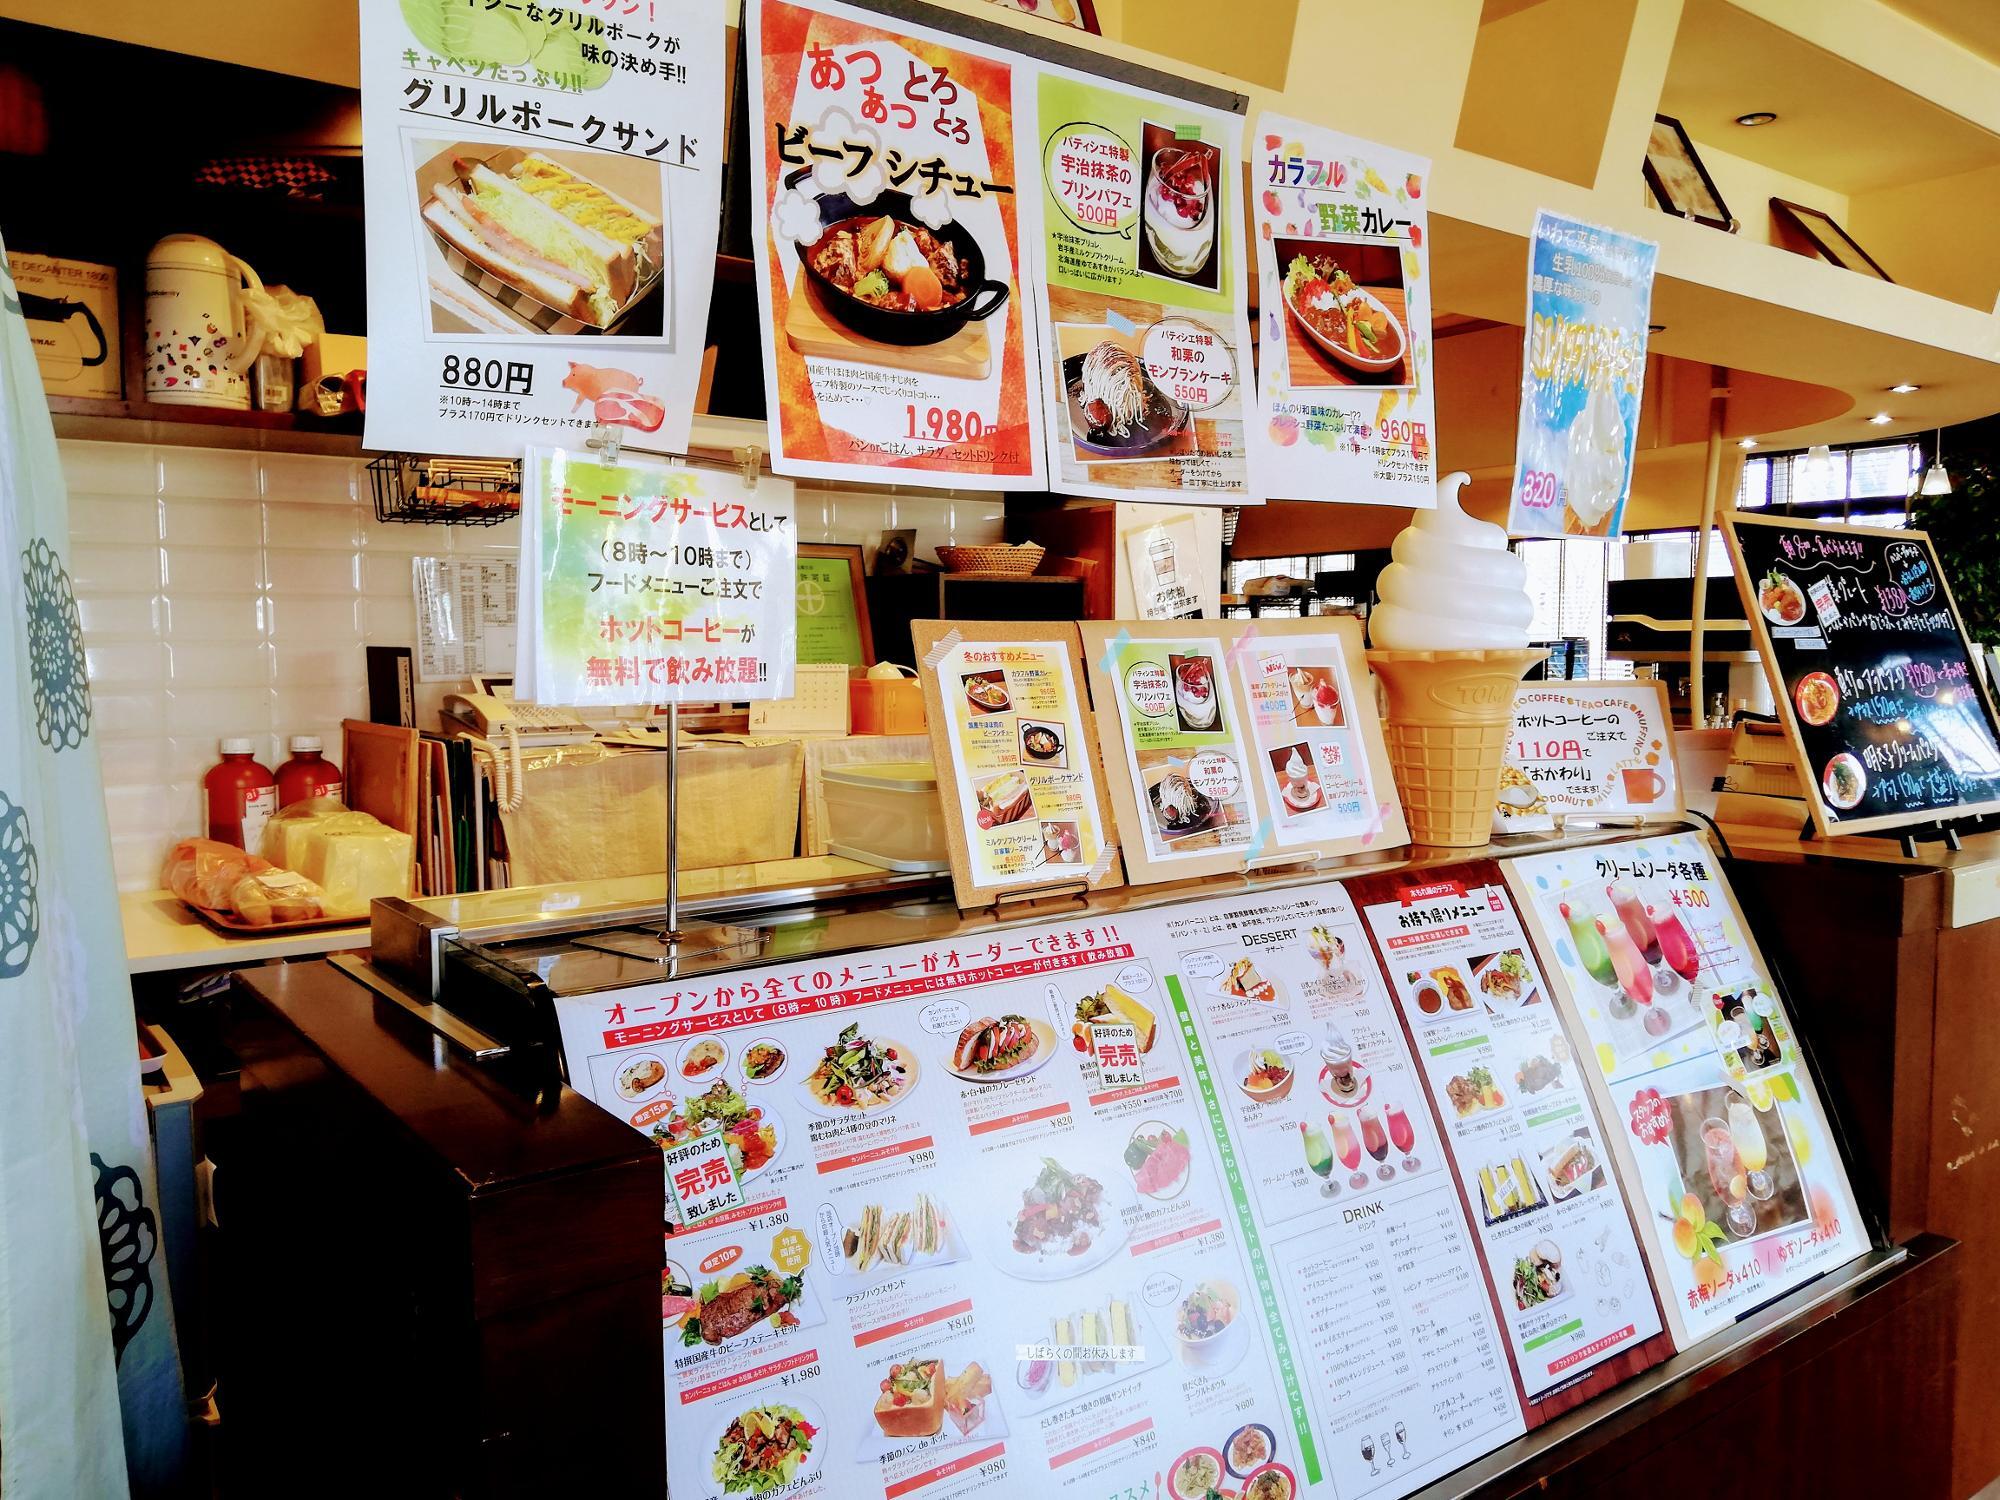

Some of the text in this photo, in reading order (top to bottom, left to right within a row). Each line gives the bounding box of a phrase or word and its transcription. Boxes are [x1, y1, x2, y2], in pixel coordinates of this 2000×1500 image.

[469, 0, 681, 54] シーなグリルポークが
[402, 48, 583, 93] キャベツたっぷり!!
[582, 43, 687, 84] 味の決め手!!
[807, 41, 958, 105] あつ とろ
[403, 77, 698, 165] グリルポークサンド
[861, 85, 970, 145] あつ とろ
[1062, 136, 1130, 163] パティシエ特製
[1061, 154, 1132, 185] 宇治抹茶の
[1268, 154, 1345, 189] カラフル
[1061, 180, 1133, 209] プリンパフェ
[1077, 202, 1118, 227] 500円
[1317, 203, 1412, 235] 野菜カレー
[1170, 346, 1205, 364] 和栗の
[442, 354, 534, 394] 880円
[1148, 364, 1232, 386] モンブランケーキ
[1174, 384, 1208, 404] 550円
[1380, 418, 1427, 446] 960円
[588, 572, 762, 600] フードメニューご注文で
[600, 614, 755, 644] ホットコーヒーが
[963, 651, 1045, 664] 冬のおすすめメニュー
[587, 655, 767, 687] 無料で飲み放題!!
[1527, 693, 1565, 704] COFFEE
[1603, 699, 1628, 709] CAFE
[1517, 713, 1620, 728] ホットコーヒーの
[1587, 731, 1627, 741] ご注文で
[1596, 859, 1709, 881] クリームソーダ各種
[1668, 889, 1710, 909] ¥500
[1398, 903, 1486, 929] お持ち帰りメニュー
[1241, 928, 1298, 947] DESSERT
[1094, 1027, 1133, 1039] 好評のため
[1098, 1043, 1138, 1067] 完売
[1104, 1073, 1141, 1083] 致しました
[1121, 1090, 1183, 1111] ¥550 ¥700
[1050, 1115, 1073, 1128] ¥820
[666, 1137, 721, 1166] 好評のため
[908, 1150, 935, 1165] ¥980
[673, 1156, 732, 1201] 完売
[686, 1191, 738, 1220] 致しました
[1342, 1200, 1386, 1225] DRINK
[749, 1212, 790, 1232] ¥1,380
[781, 1364, 822, 1388] ¥1,980
[979, 1458, 1007, 1478] ¥980
